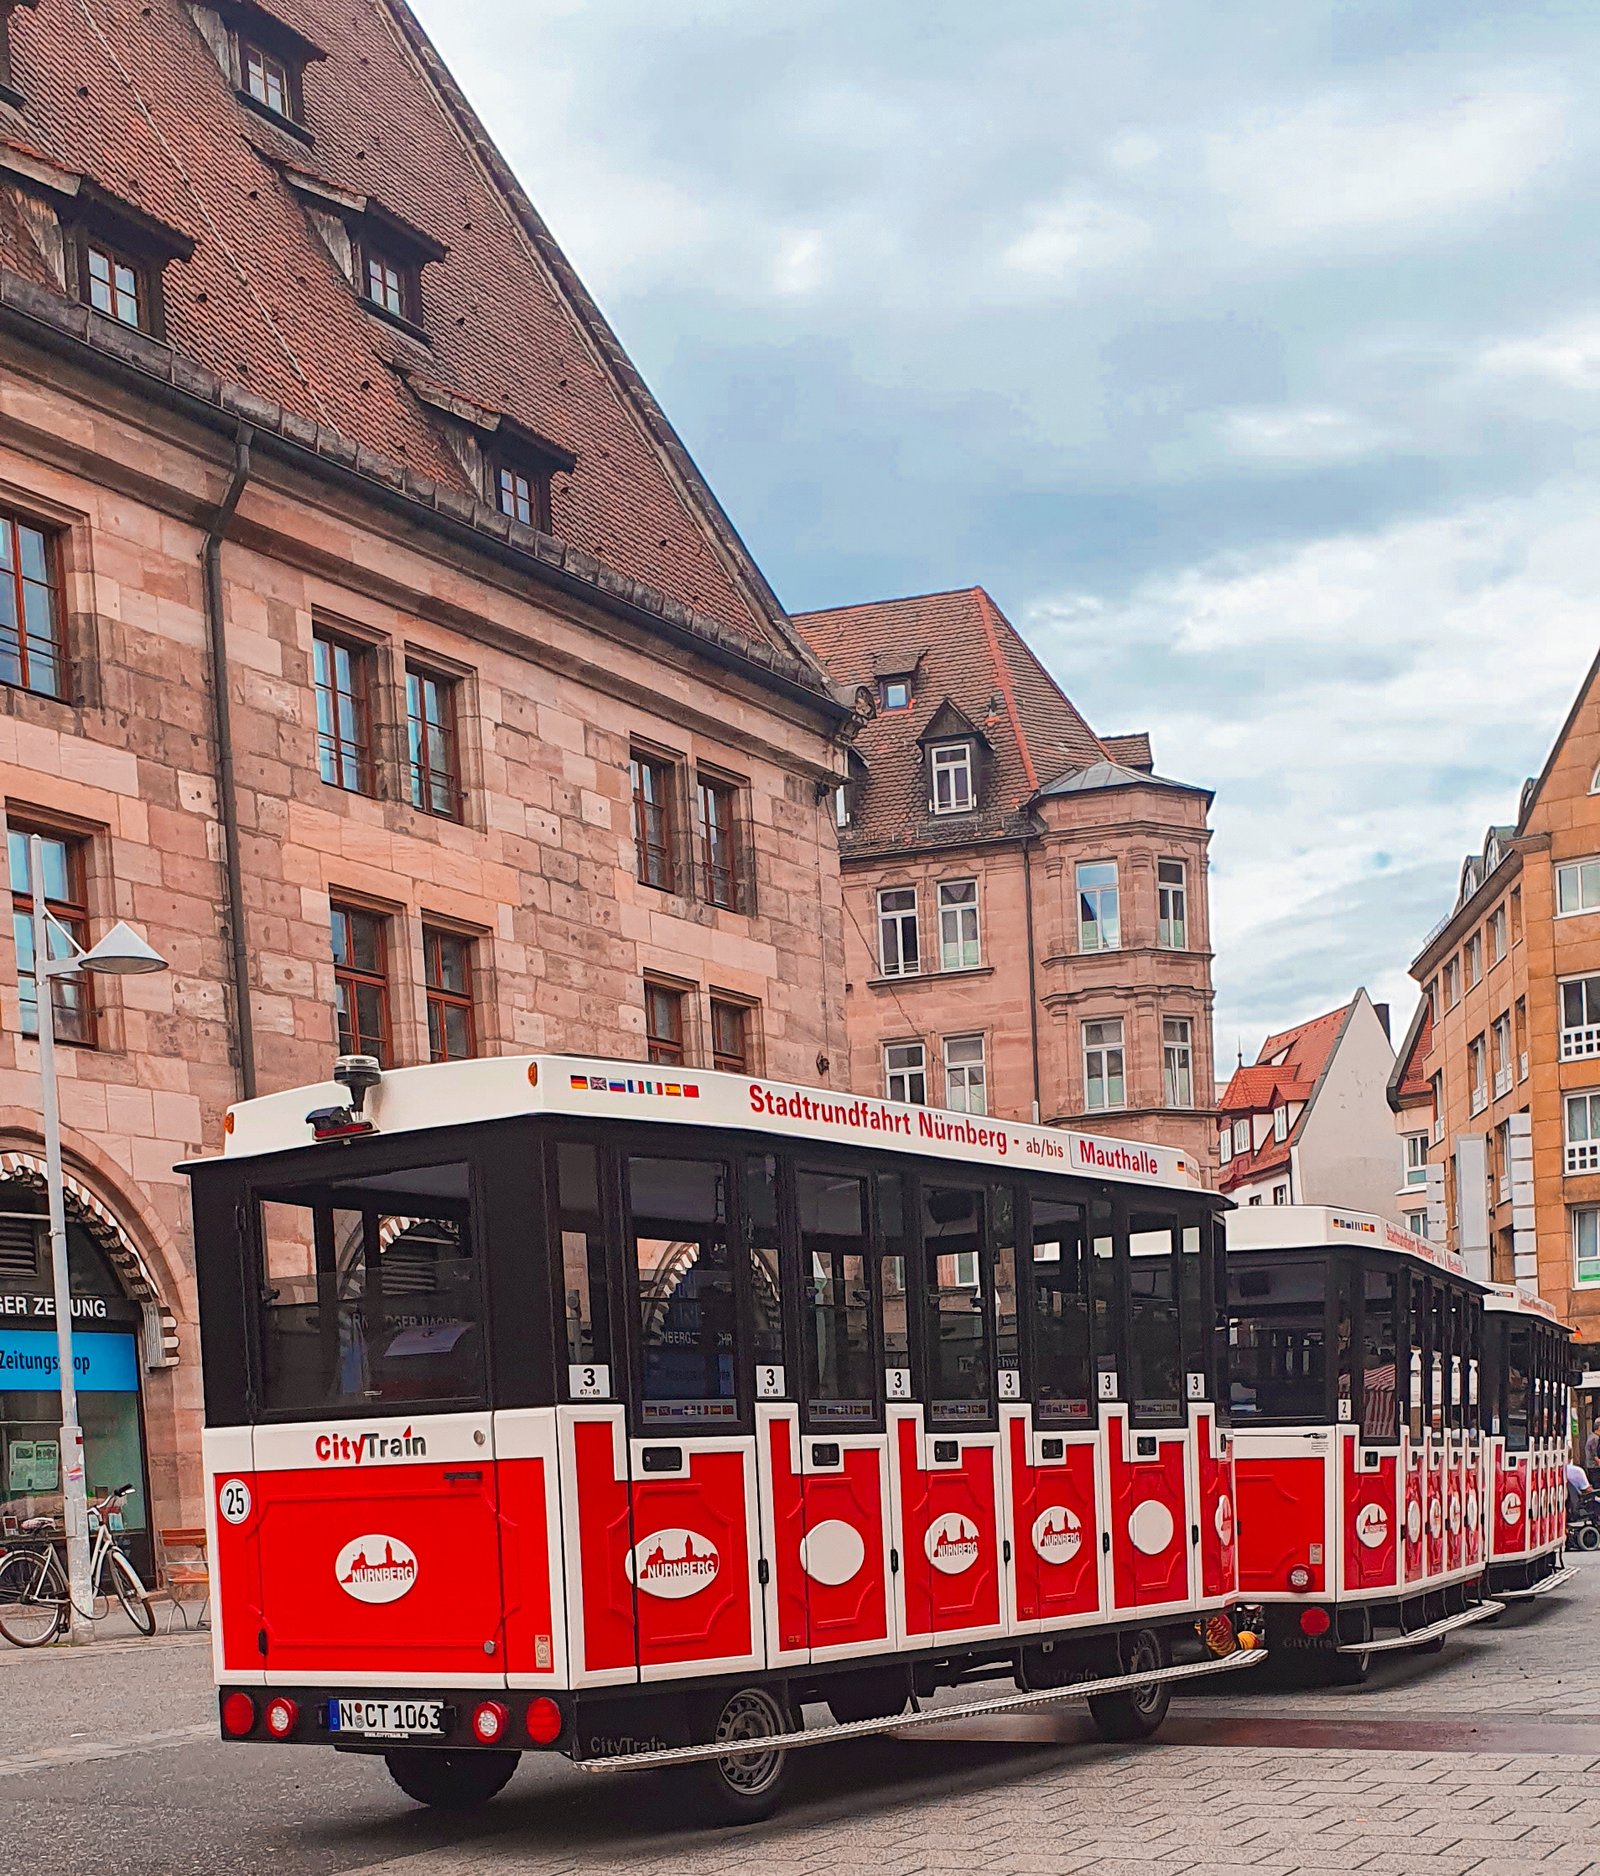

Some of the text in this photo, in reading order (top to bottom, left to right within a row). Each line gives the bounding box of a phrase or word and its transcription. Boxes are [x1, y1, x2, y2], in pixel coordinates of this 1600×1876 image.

[749, 1084, 911, 1135] Stadtrundfahrt
[918, 1111, 1007, 1155] Nürnberg
[1026, 1137, 1064, 1158] ab/bis
[1079, 1140, 1158, 1175] Mauthalle
[0, 1296, 28, 1315] ER
[583, 1367, 596, 1387] 3
[766, 1368, 775, 1387] 3
[894, 1371, 902, 1389] 3
[1005, 1373, 1012, 1389] 3
[1105, 1374, 1111, 1390] 3
[1193, 1375, 1199, 1390] 3
[1342, 1401, 1347, 1414] 2
[315, 1425, 427, 1465] CityTrain
[226, 1488, 245, 1515] 25
[1043, 1531, 1080, 1546] NÜRNBERG
[937, 1541, 978, 1557] NÜRNBERG
[352, 1564, 415, 1583] NÜRNBERG
[647, 1560, 715, 1578] NÜRNBERG
[340, 1703, 440, 1729] N CT 1063
